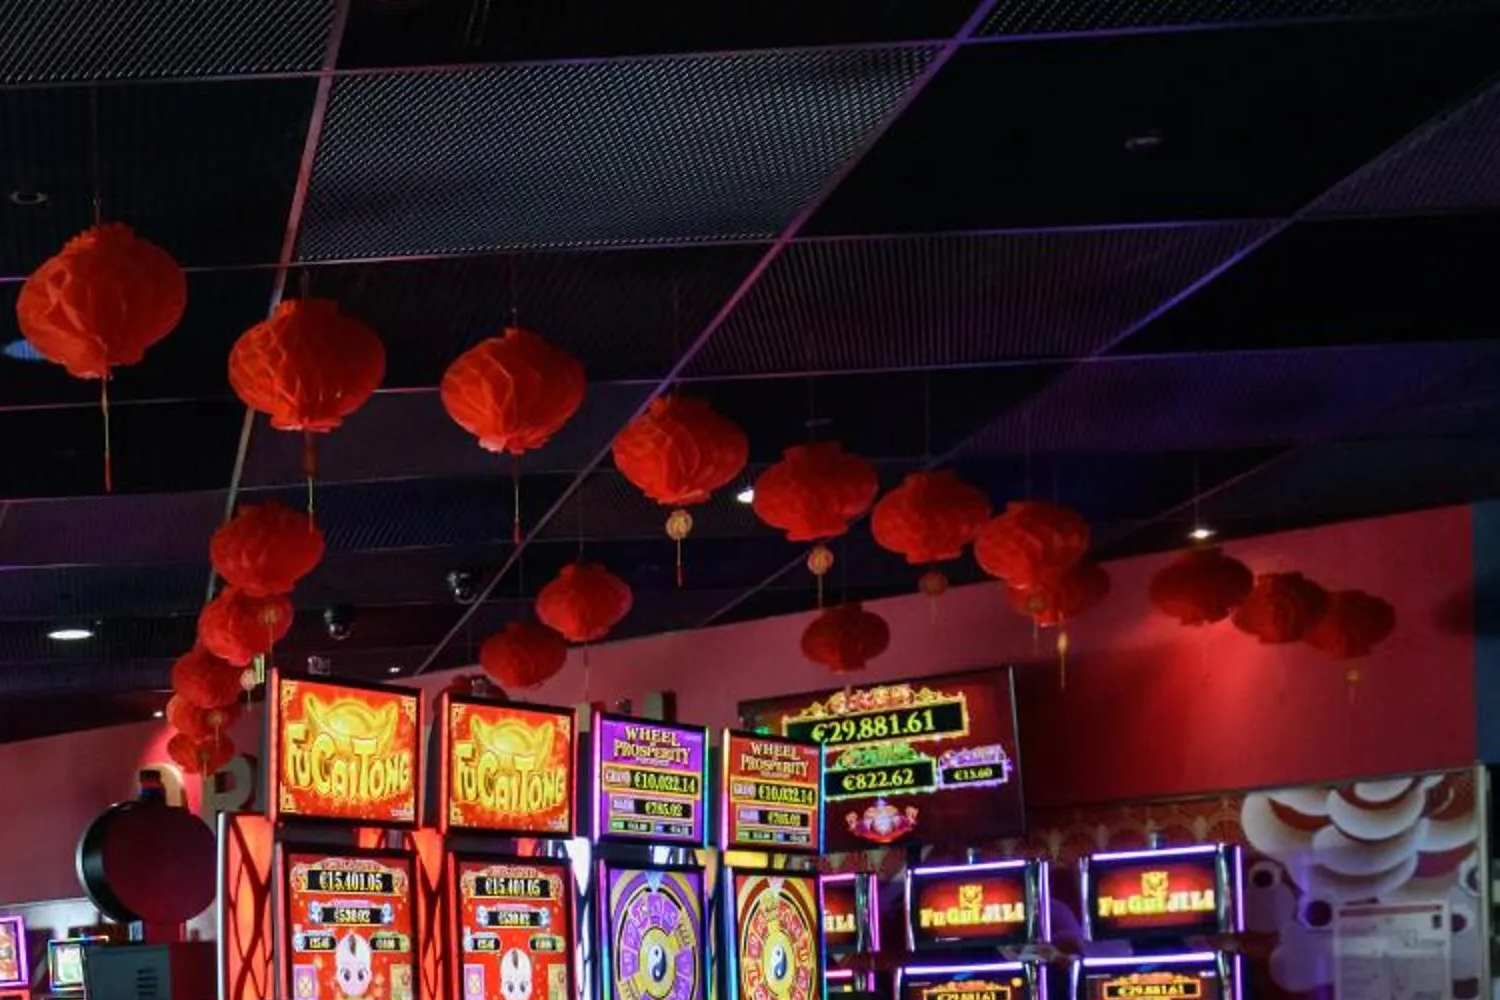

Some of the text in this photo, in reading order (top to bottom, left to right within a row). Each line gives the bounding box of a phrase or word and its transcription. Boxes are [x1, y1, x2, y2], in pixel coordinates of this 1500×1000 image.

[625, 726, 680, 746] WHEEL
[811, 708, 936, 744] €29,881.61
[613, 740, 691, 764] PROSPERITY
[751, 742, 800, 760] WHEEL
[740, 754, 809, 777] PROSPERITY
[843, 768, 914, 790] €822.62
